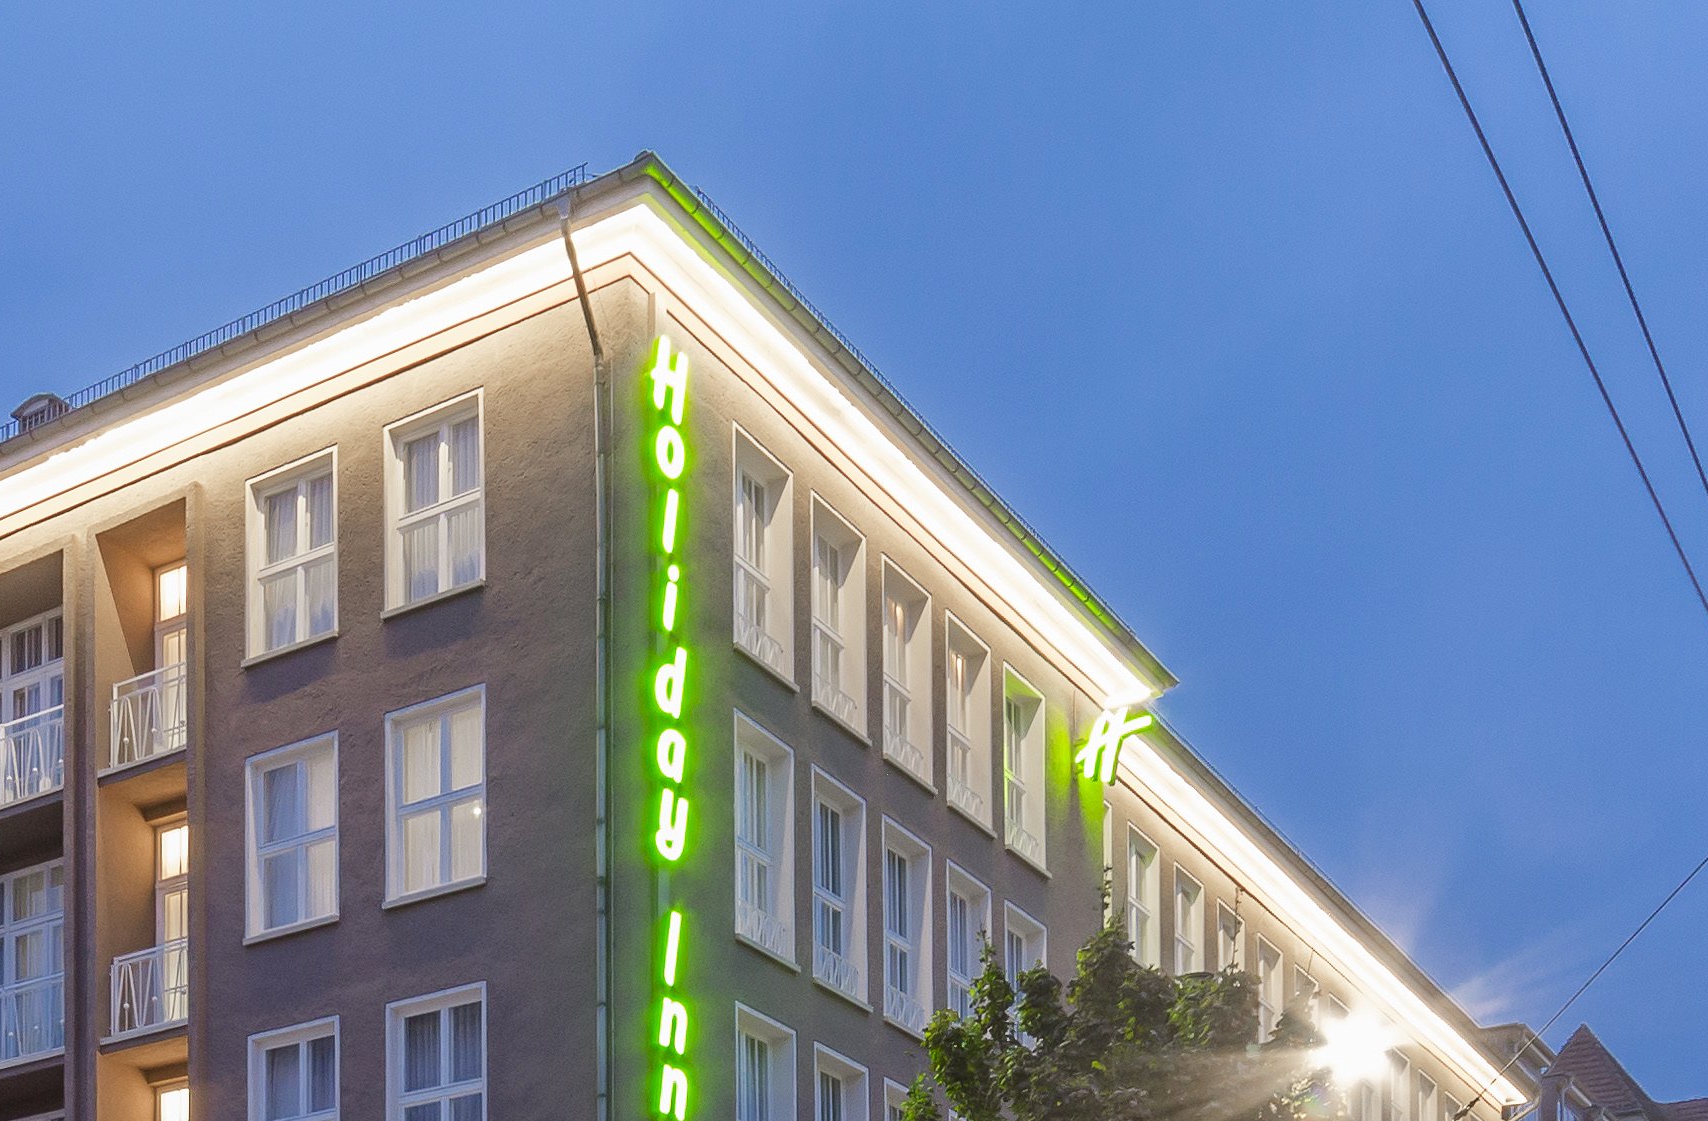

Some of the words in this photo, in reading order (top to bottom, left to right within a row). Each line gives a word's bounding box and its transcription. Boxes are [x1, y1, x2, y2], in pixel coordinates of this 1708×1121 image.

[650, 334, 689, 861] Holiday
[1074, 706, 1153, 786] H
[658, 910, 688, 1121] Inn
